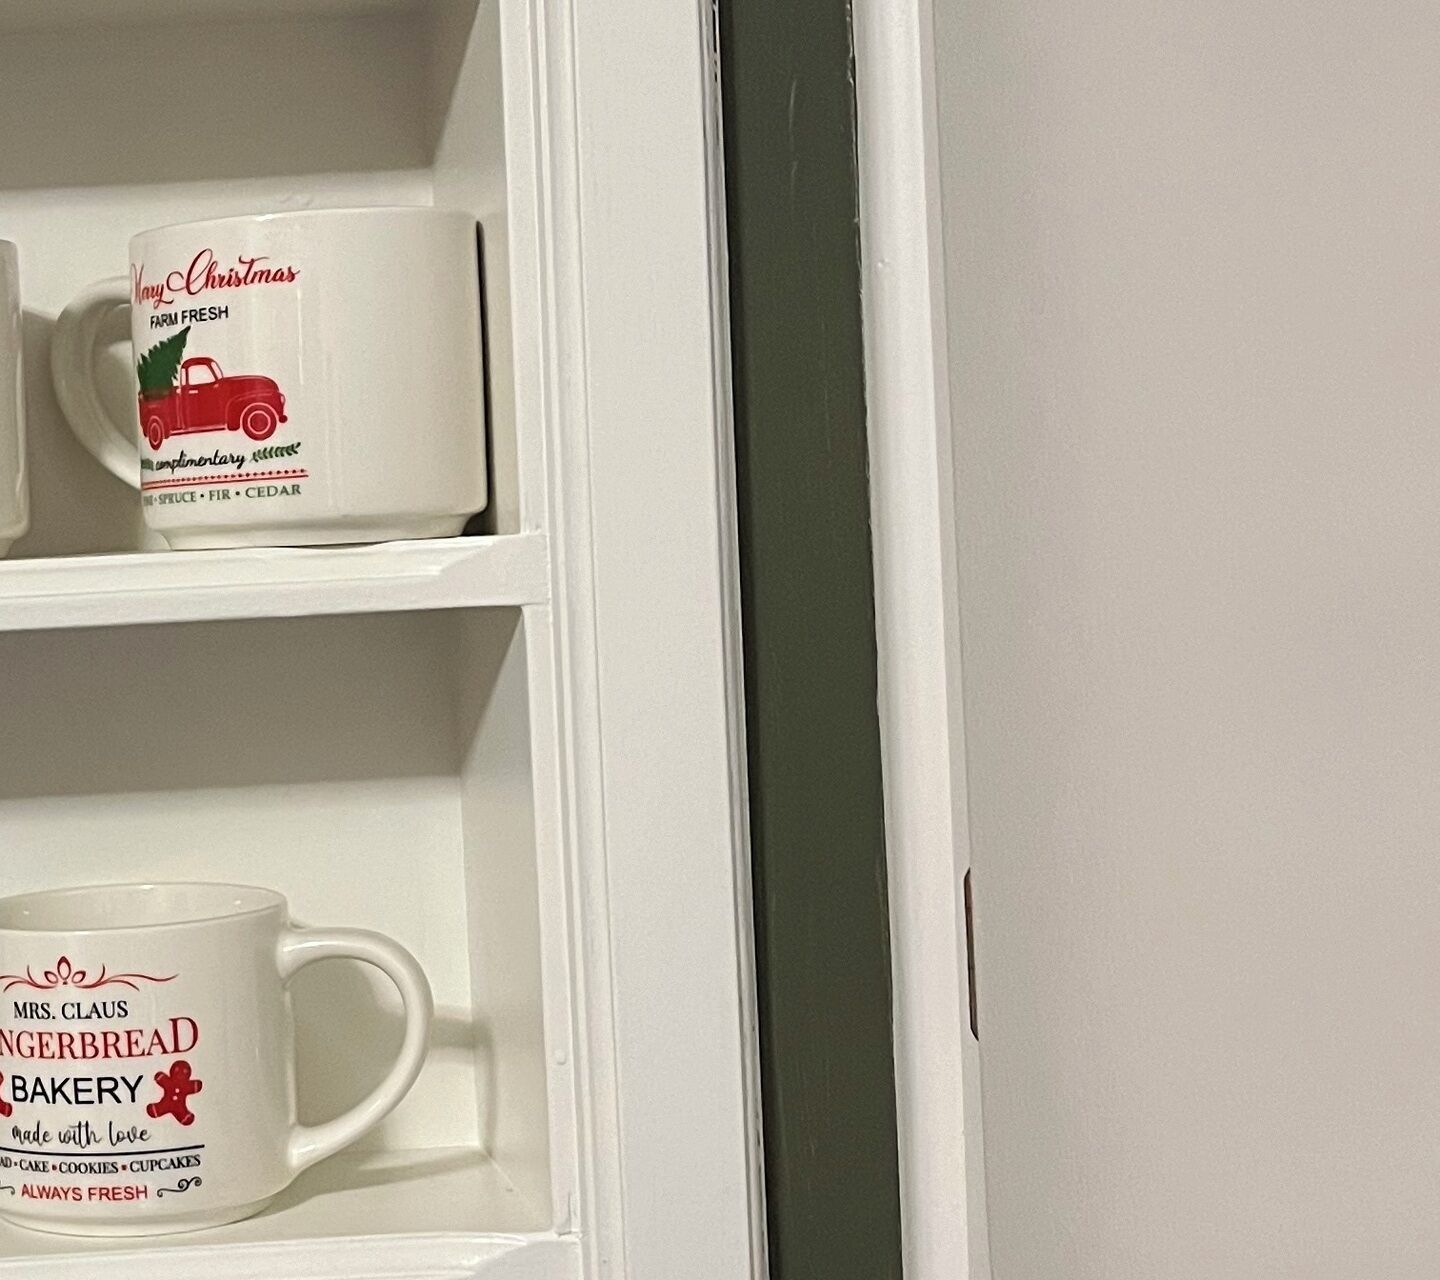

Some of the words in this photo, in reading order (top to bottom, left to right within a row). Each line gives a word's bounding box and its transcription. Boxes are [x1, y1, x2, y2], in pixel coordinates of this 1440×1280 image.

[166, 248, 301, 297] Christmas
[150, 313, 178, 330] FARM
[182, 305, 229, 323] FRESH
[158, 491, 197, 505] SPRUCE
[209, 487, 231, 501] FIR
[245, 484, 301, 498] CEDAR
[13, 1001, 55, 1020] MRS.
[61, 1001, 129, 1020] CLAUS
[11, 1074, 144, 1105] BAKERY
[11, 1121, 53, 1145] made
[58, 1121, 102, 1148] with
[109, 1121, 152, 1146] love
[19, 1159, 49, 1173] CAKE
[59, 1161, 119, 1174] COOKIES
[129, 1155, 201, 1173] CUPCAKES
[21, 1184, 82, 1201] ALWAYS
[88, 1185, 148, 1201] FRESH
